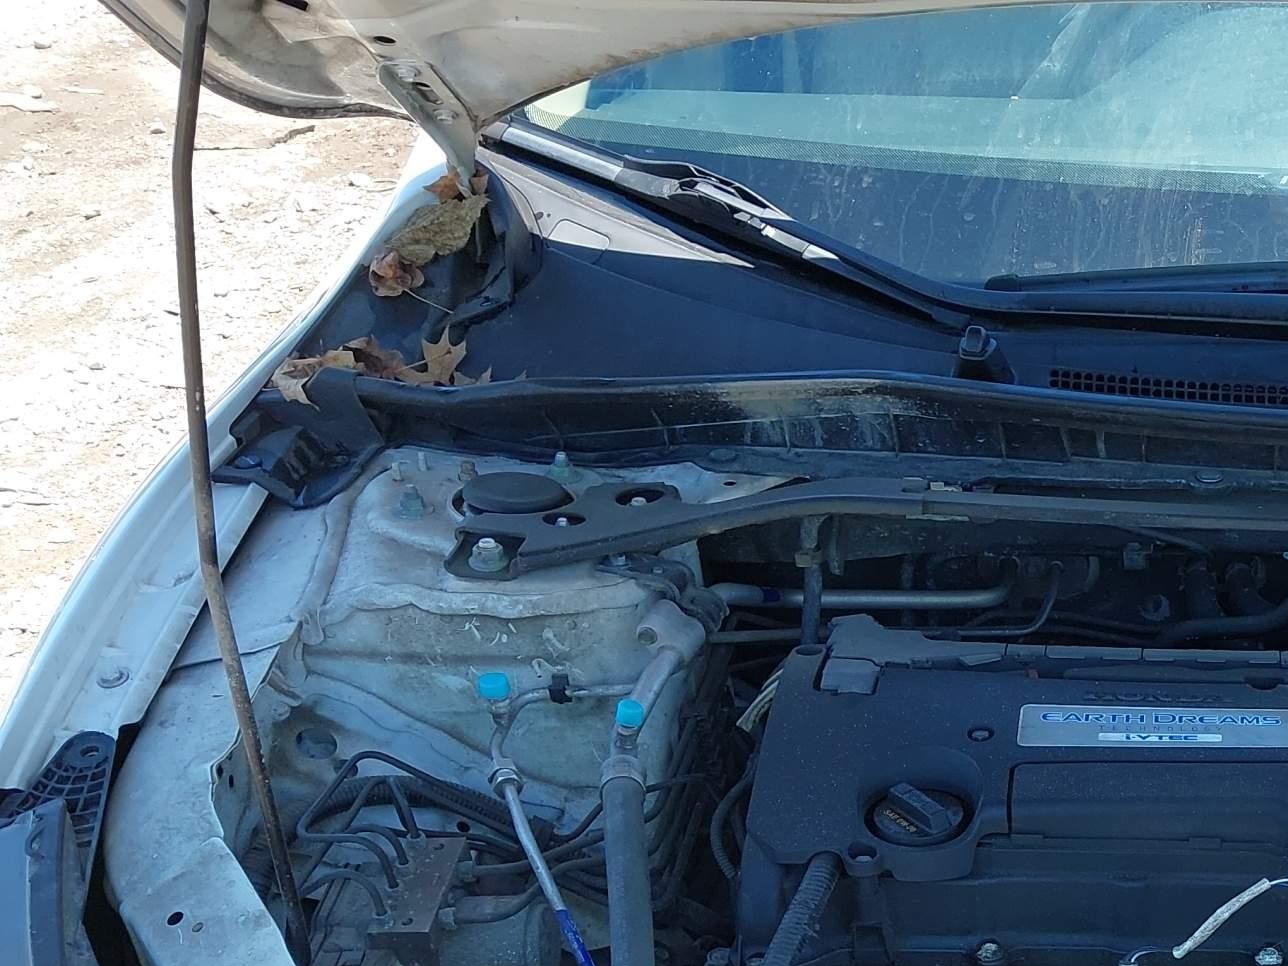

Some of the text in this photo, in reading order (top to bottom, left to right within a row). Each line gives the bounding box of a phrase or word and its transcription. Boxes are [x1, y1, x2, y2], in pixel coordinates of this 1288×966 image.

[1041, 711, 1281, 727] EARTH DREAMS
[1100, 725, 1222, 733] TECHNOLOGY
